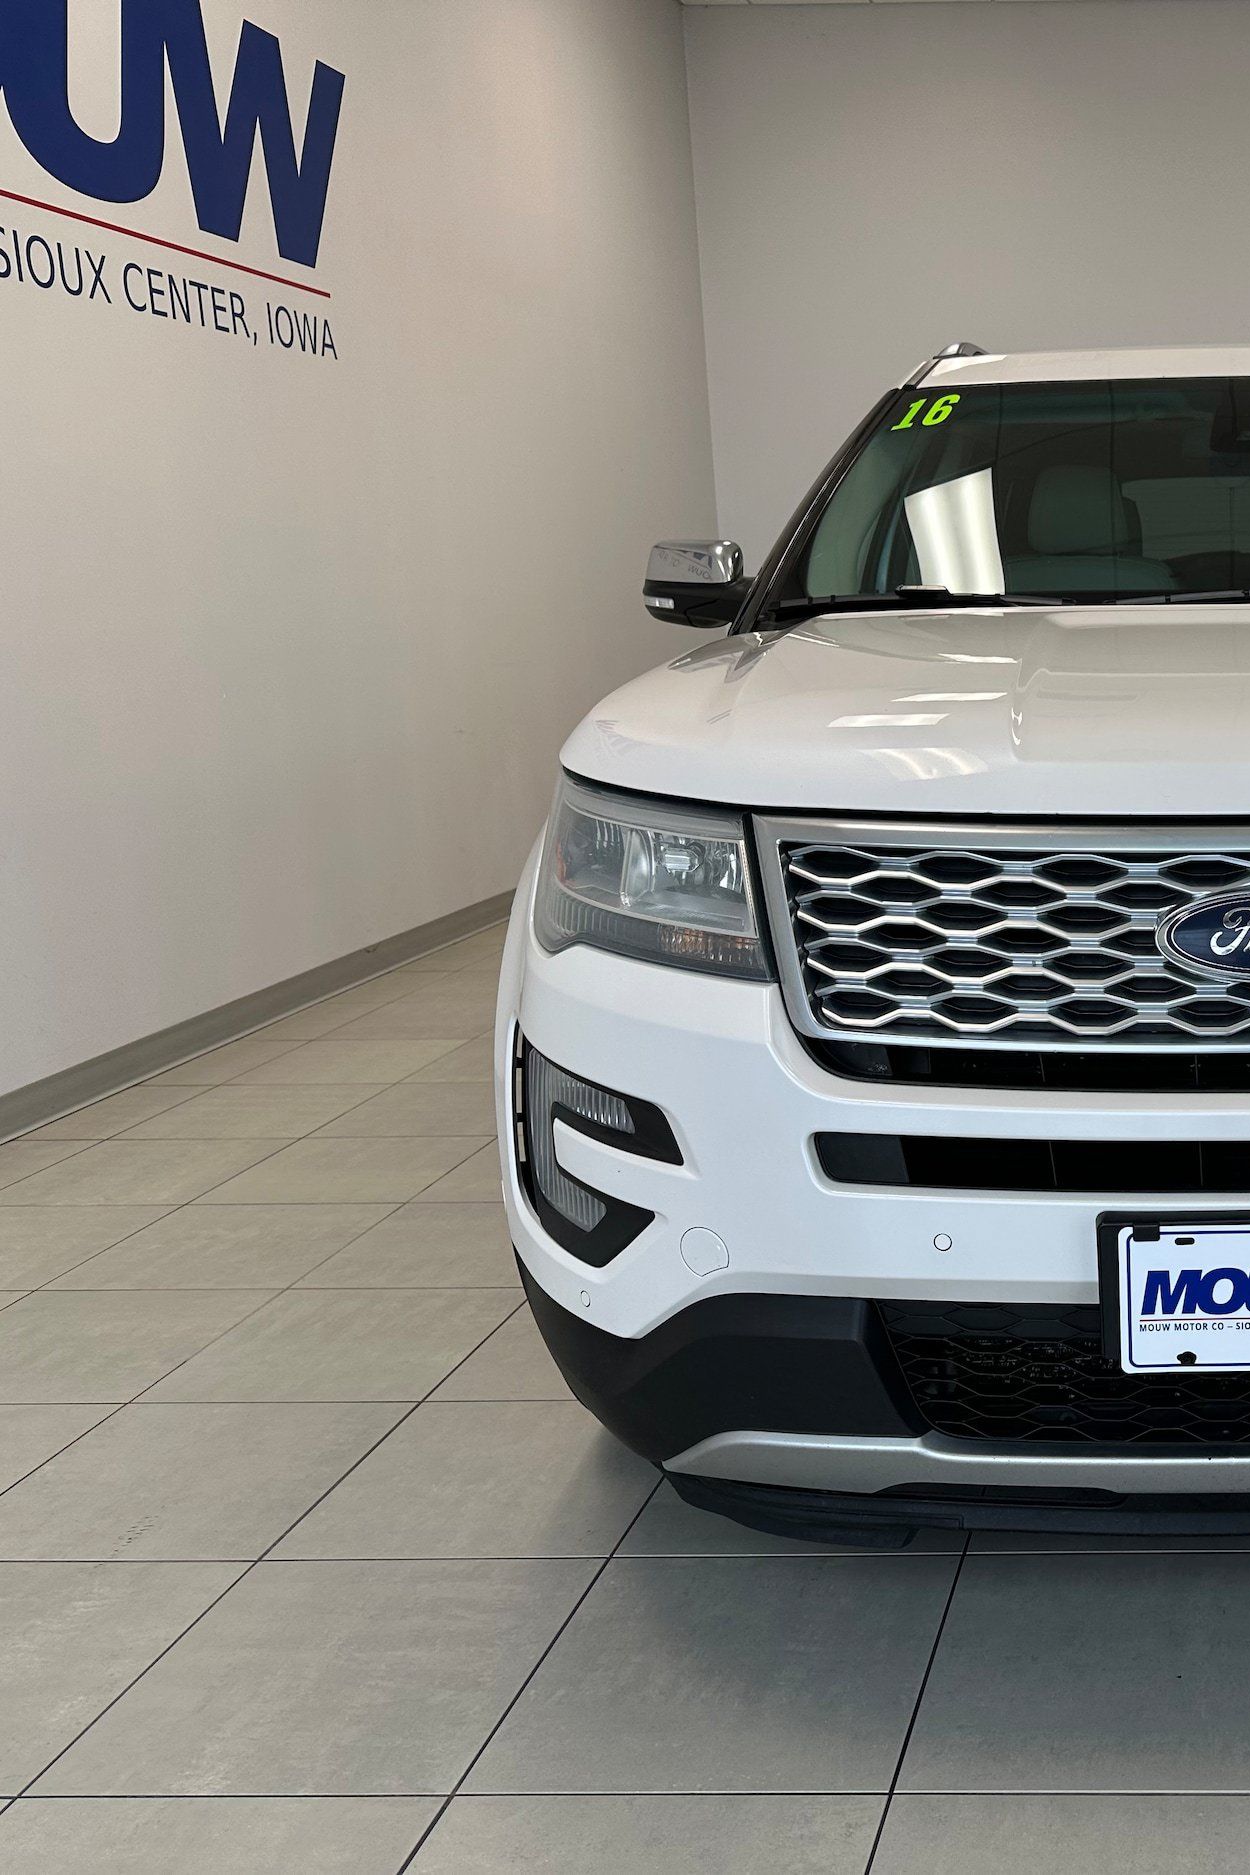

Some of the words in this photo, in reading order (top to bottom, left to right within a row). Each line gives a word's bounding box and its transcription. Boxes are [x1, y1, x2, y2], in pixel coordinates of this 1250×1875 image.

[0, 0, 346, 268] UW
[122, 262, 258, 346] CENTER,
[266, 302, 338, 360] IOWA
[890, 393, 961, 431] 16
[1139, 1323, 1171, 1332] MOUW
[1174, 1322, 1209, 1331] MOTOR
[1211, 1322, 1224, 1331] CO
